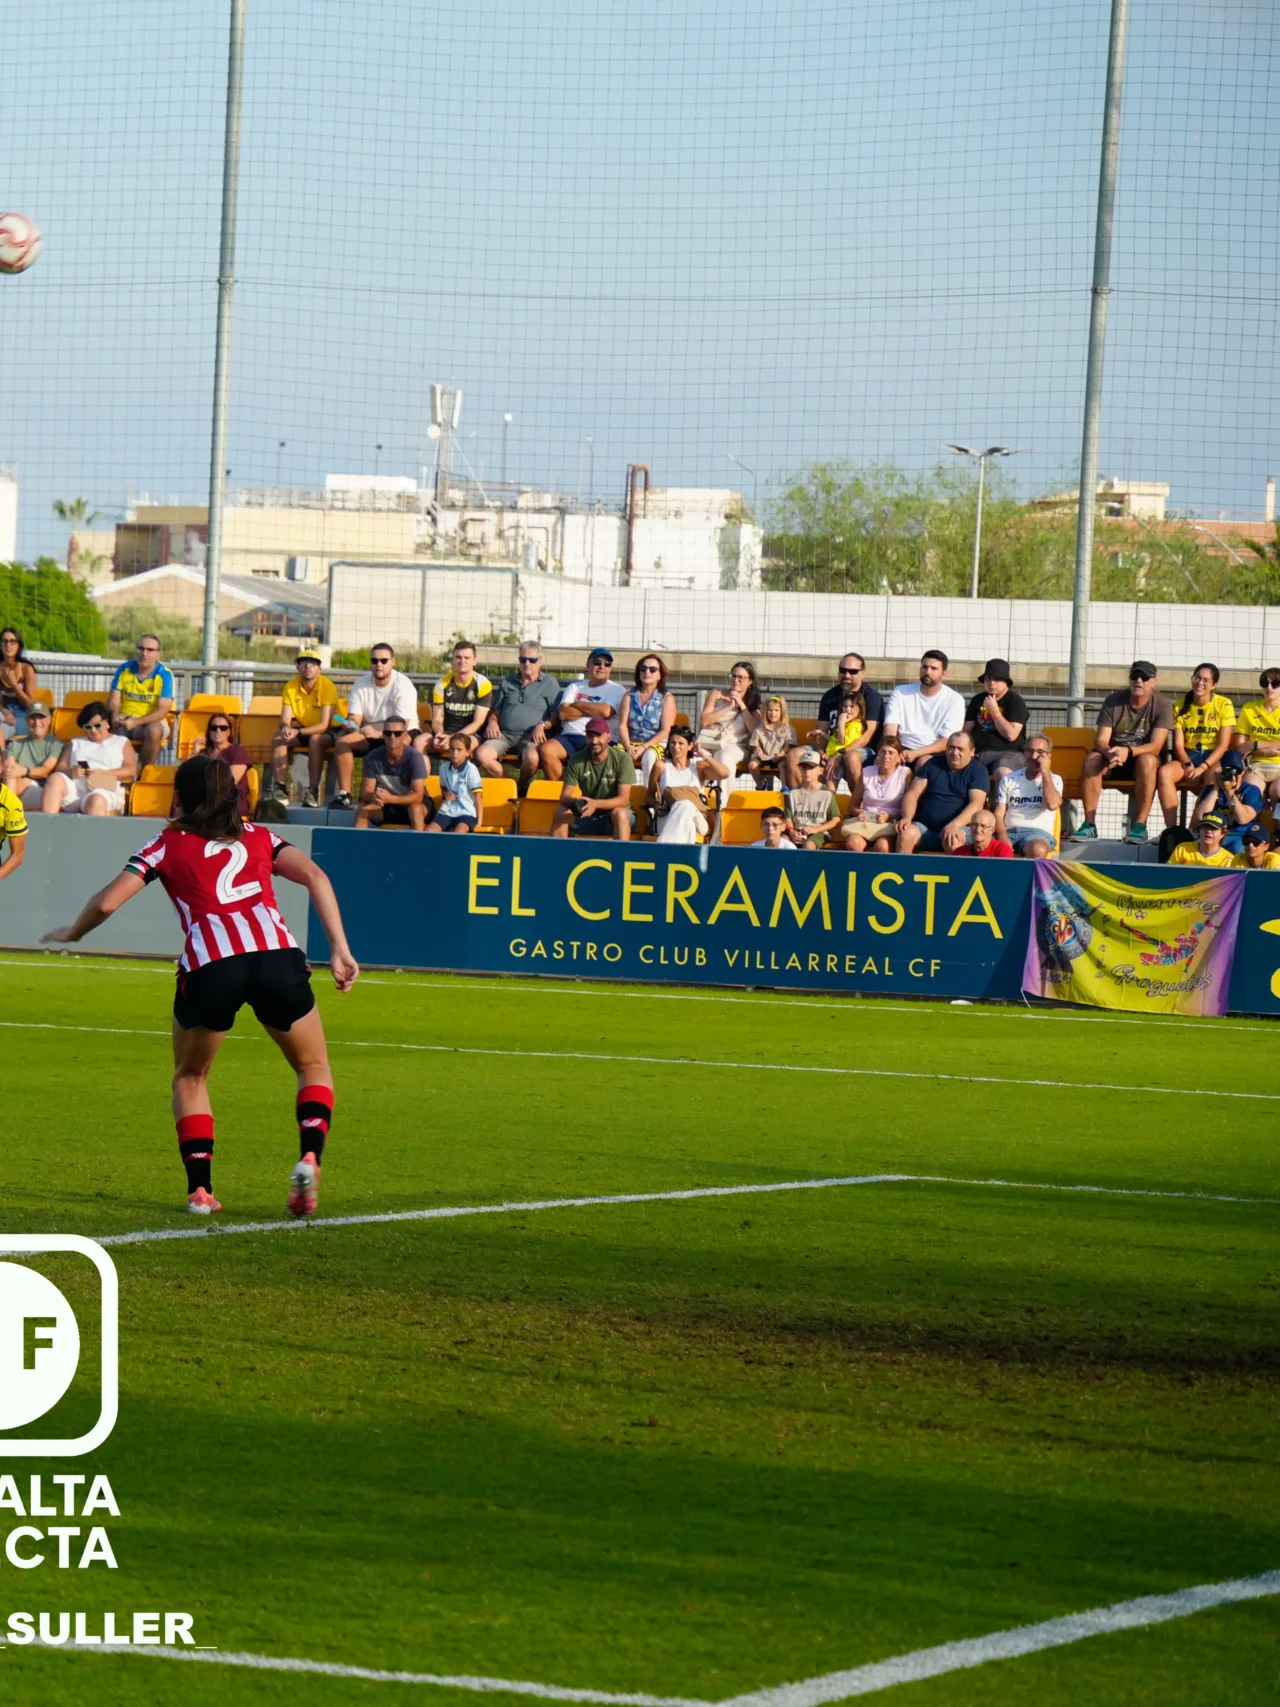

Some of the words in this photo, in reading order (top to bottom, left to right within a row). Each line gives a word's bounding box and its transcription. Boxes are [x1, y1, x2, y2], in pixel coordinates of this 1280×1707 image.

[1251, 725, 1280, 735] PAMES
[204, 840, 263, 905] 2
[468, 854, 536, 917] EL
[566, 858, 1004, 939] CERAMISTA
[509, 938, 623, 962] GASTRO
[639, 944, 708, 966] CLUB
[724, 949, 894, 976] VILLARREAL
[908, 957, 942, 978] CF
